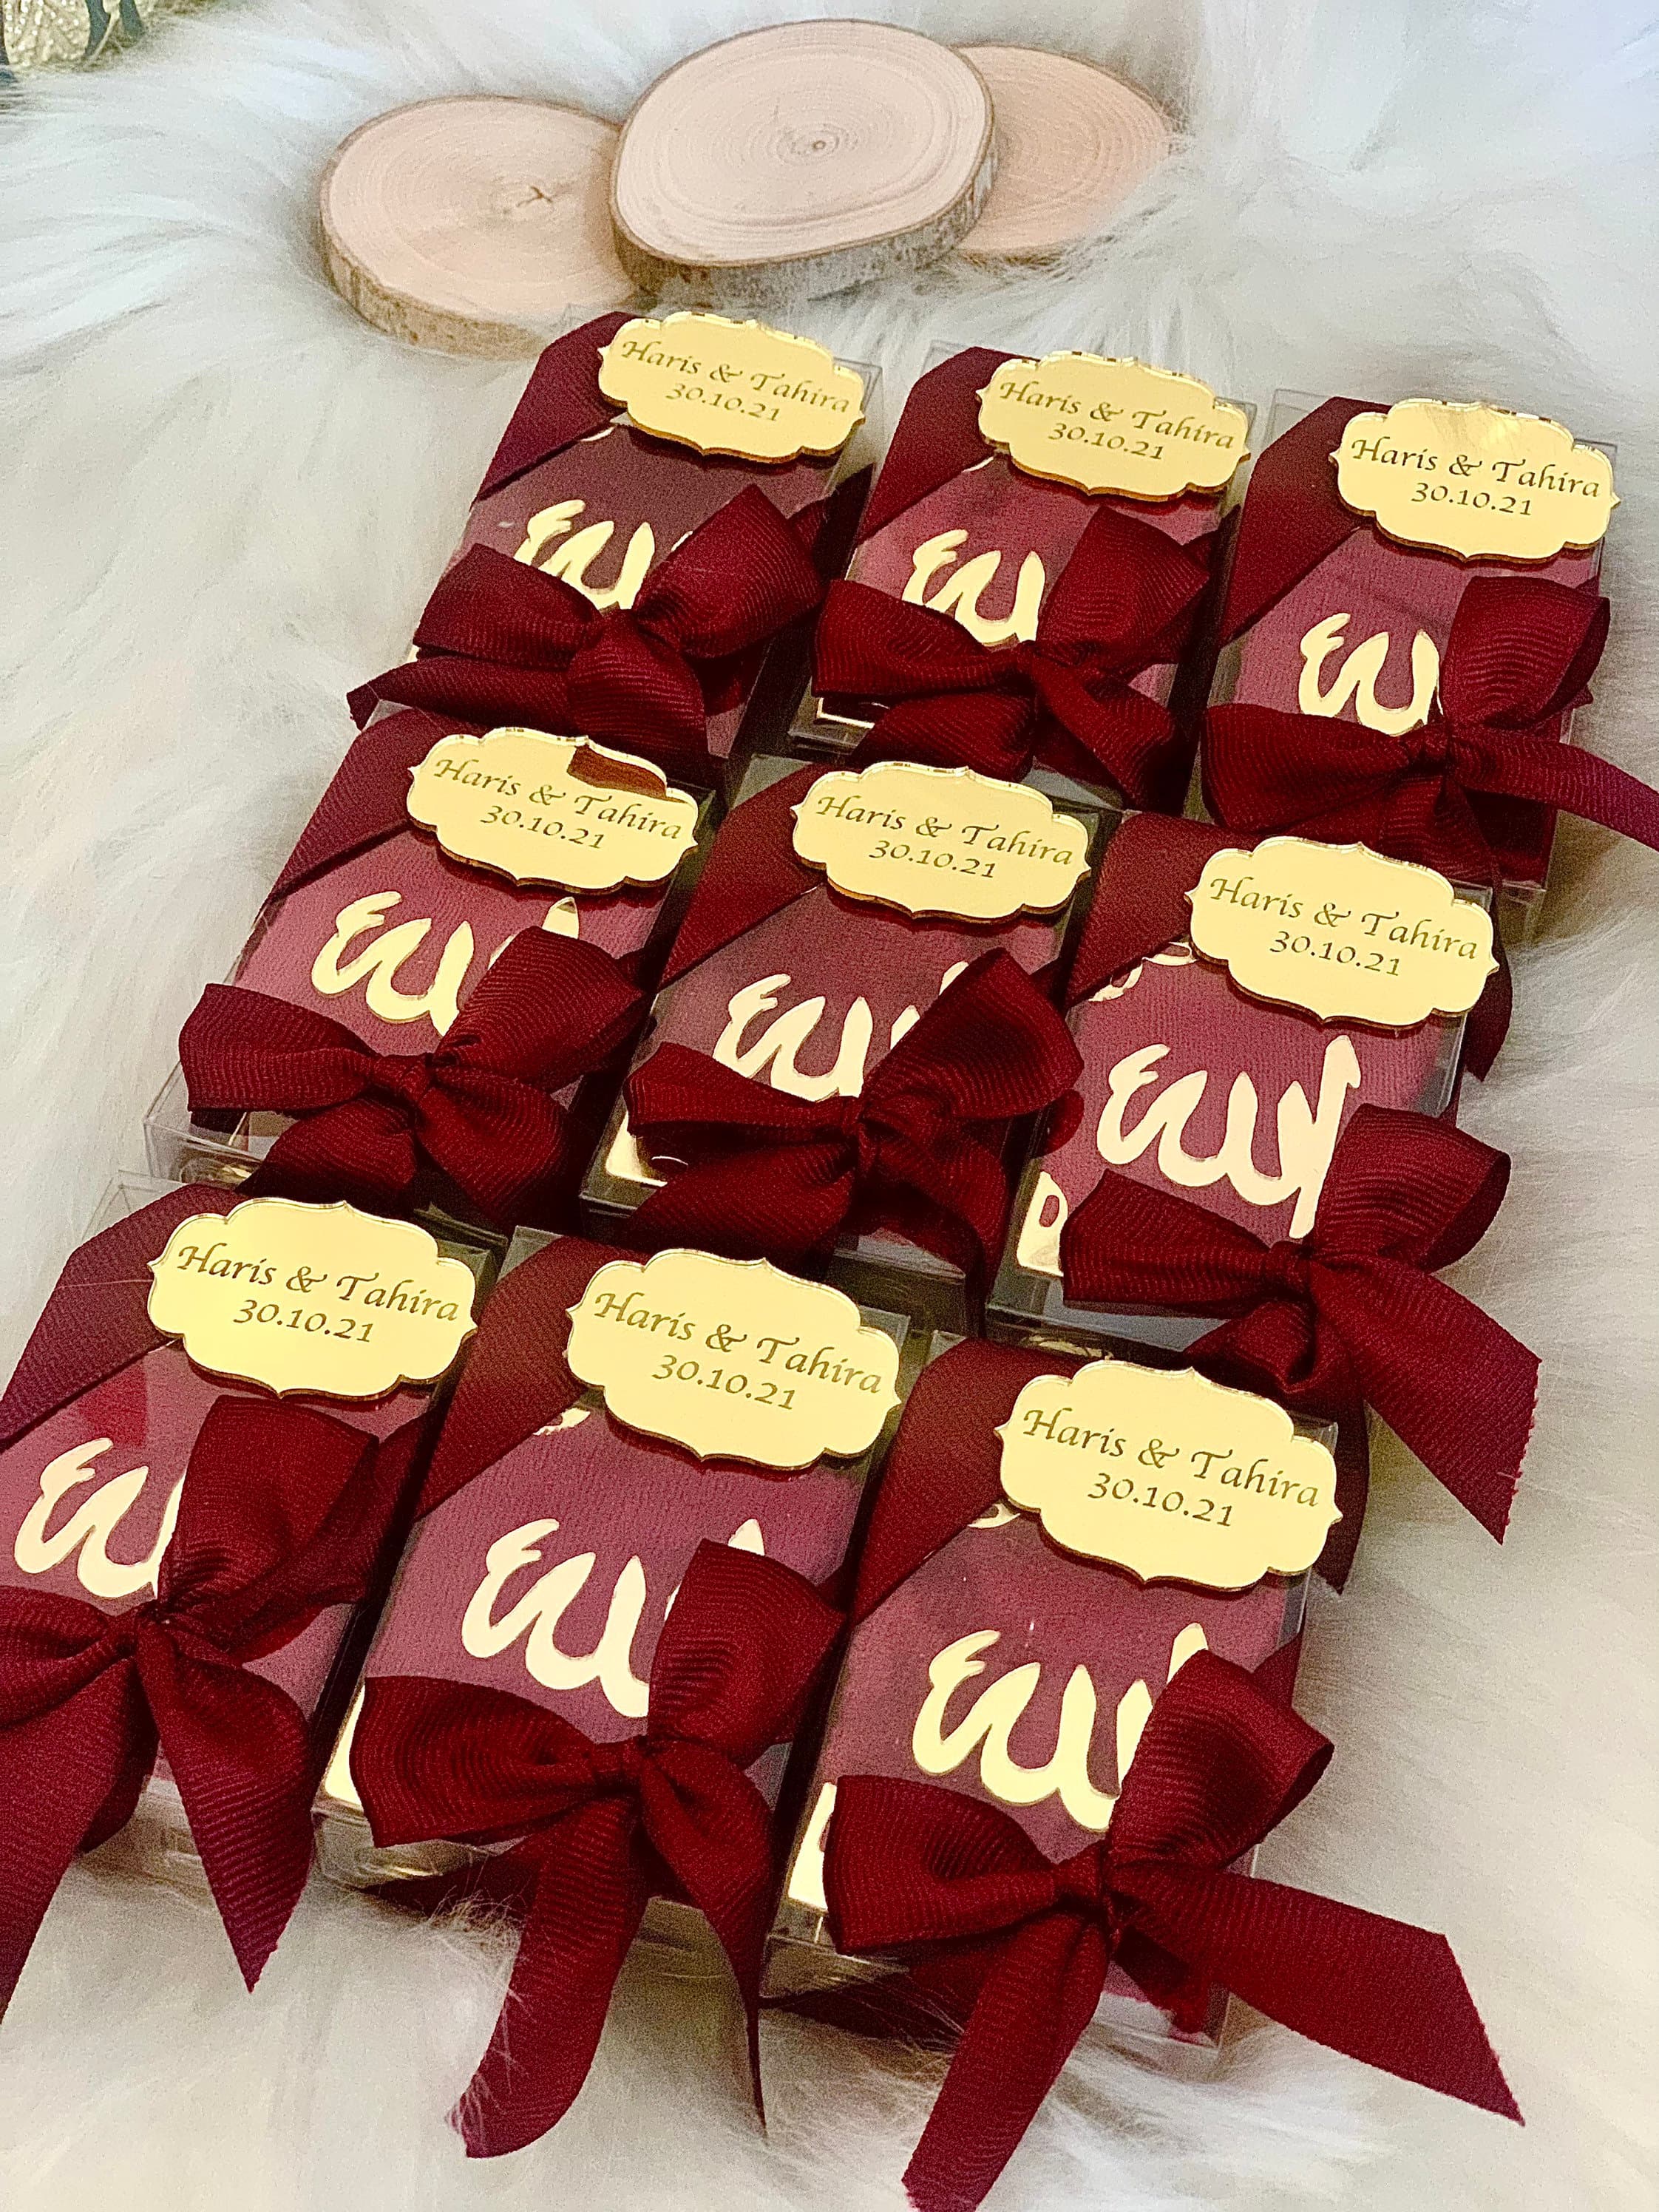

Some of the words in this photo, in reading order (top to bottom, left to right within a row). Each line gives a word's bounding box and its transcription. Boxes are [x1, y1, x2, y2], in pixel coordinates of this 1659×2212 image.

[622, 340, 701, 375] Haris
[709, 364, 743, 383] &
[750, 373, 849, 413] Tahira
[665, 383, 781, 421] 30.10.21
[1000, 381, 1081, 413] Haris
[1089, 402, 1123, 421] &
[1132, 410, 1233, 449] Tahira
[1048, 423, 1164, 459] 30.10.21
[1351, 436, 1437, 471] Haris
[1449, 455, 1482, 476] &
[1492, 459, 1599, 497] Tahira
[1411, 483, 1531, 515] 30.10.21
[434, 759, 520, 796] Haris
[529, 785, 566, 805] &
[574, 795, 681, 839] Tahira
[480, 805, 605, 849] 30.10.21
[816, 795, 906, 830] Haris
[915, 817, 951, 838] &
[962, 824, 1072, 864] Tahira
[869, 841, 997, 878] 30.10.21
[1210, 876, 1303, 918] Haris
[1314, 903, 1351, 927] &
[1362, 912, 1477, 959] Tahira
[1270, 931, 1400, 976] 30.10.21
[177, 1243, 276, 1285] Haris
[286, 1266, 328, 1292] &
[336, 1272, 458, 1320] Tahira
[234, 1300, 373, 1343] 30.10.21
[594, 1292, 696, 1340] Haris
[705, 1324, 747, 1351] &
[756, 1337, 881, 1394] Tahira
[652, 1354, 796, 1410] 30.10.21
[1023, 1408, 1126, 1456] Haris
[1138, 1439, 1179, 1468] &
[1191, 1449, 1318, 1507] Tahira
[1088, 1473, 1232, 1526] 30.10.21
